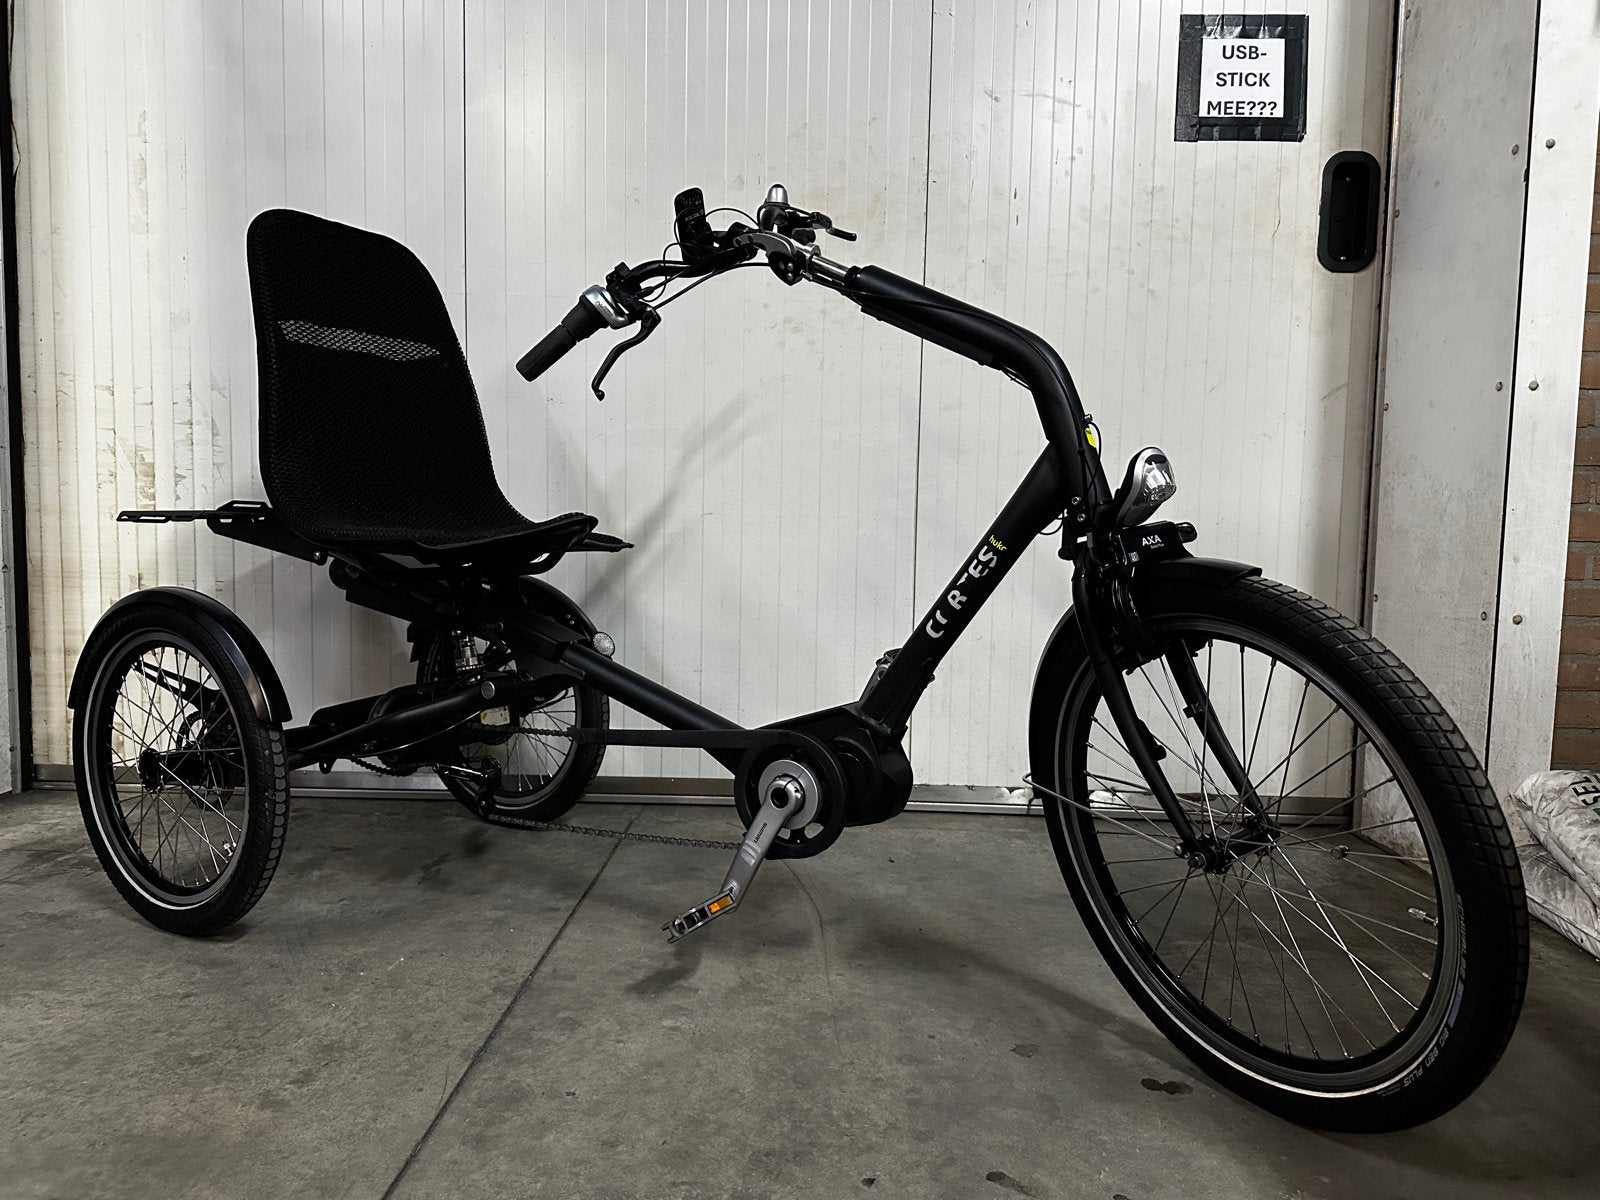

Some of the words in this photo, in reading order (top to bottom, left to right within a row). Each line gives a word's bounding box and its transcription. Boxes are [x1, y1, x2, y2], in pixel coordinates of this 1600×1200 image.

[1222, 45, 1267, 60] USB-
[1215, 72, 1271, 87] STICK
[1207, 101, 1277, 116] MEE???
[1142, 534, 1162, 547] AXA
[1403, 1065, 1423, 1087] PLUS
